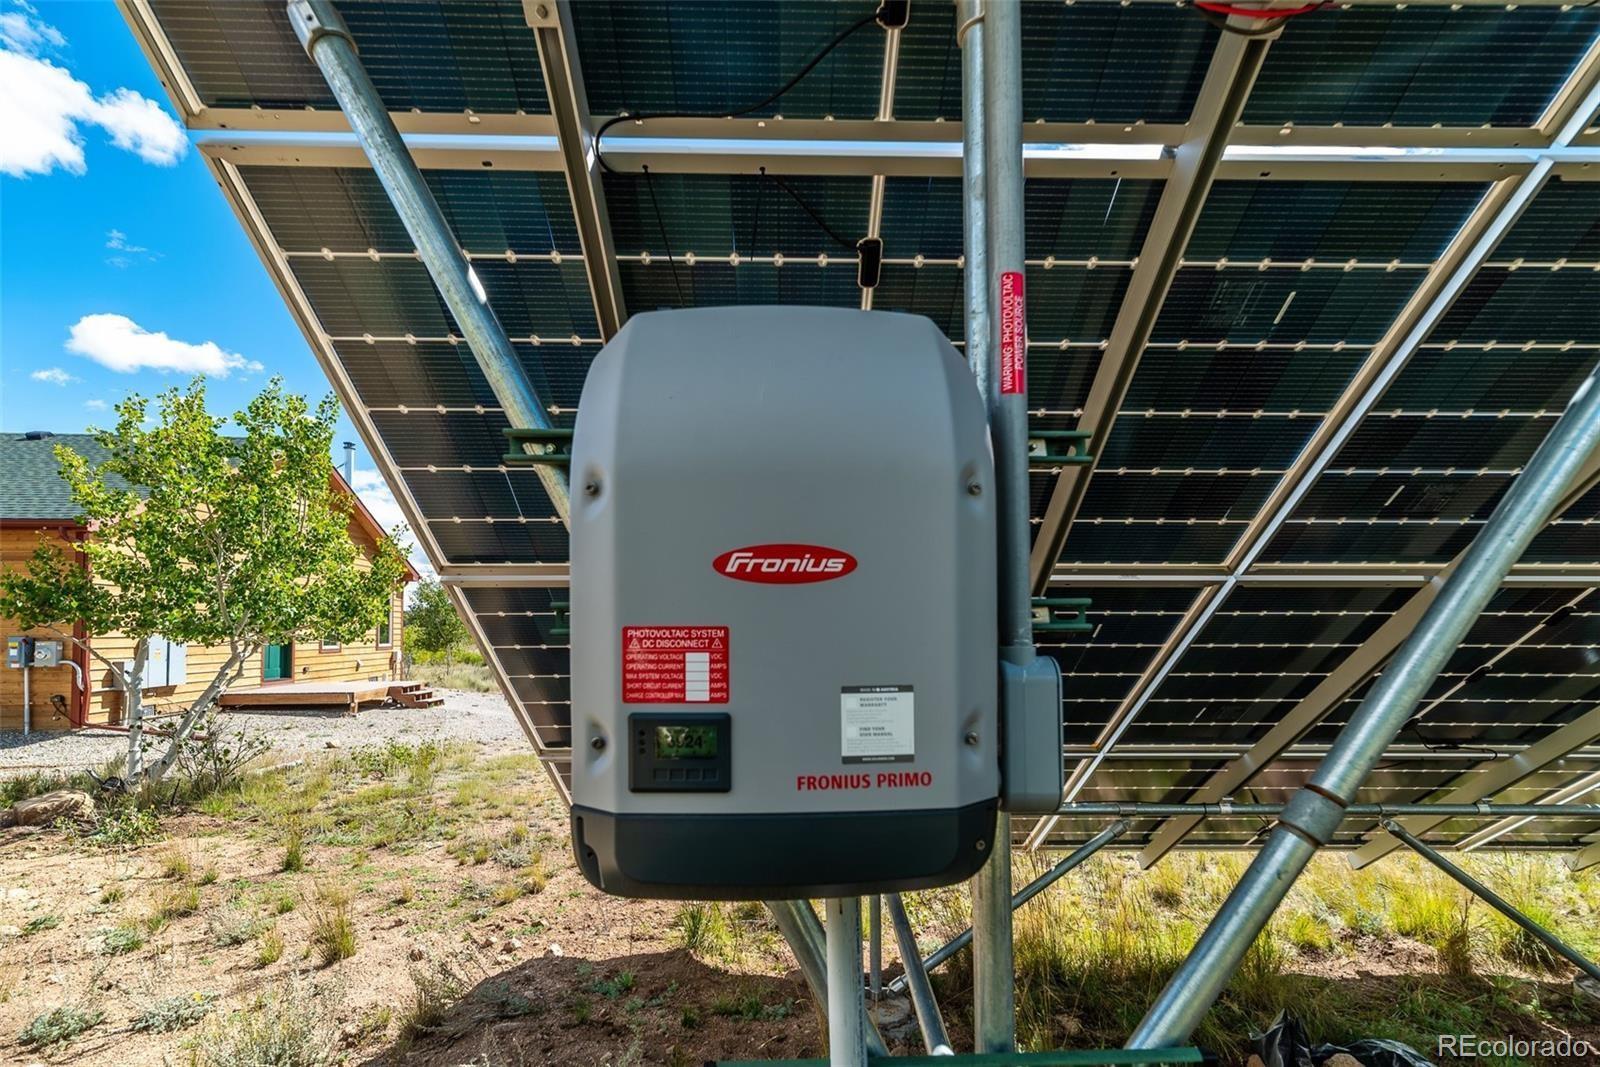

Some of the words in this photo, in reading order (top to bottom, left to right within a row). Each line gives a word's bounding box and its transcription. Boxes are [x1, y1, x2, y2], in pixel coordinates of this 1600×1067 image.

[1002, 274, 1014, 342] PHOTOVOLTAIC
[1014, 295, 1024, 335] SOURCE
[1014, 336, 1024, 370] POWER
[1002, 343, 1014, 391] WARNING:
[725, 552, 847, 573] Fronius
[627, 629, 689, 638] PHOTOVOLTAIC
[690, 629, 725, 638] SYSTEM
[642, 639, 655, 648] DC
[656, 639, 709, 648] DISCONNECT
[797, 773, 872, 791] FRONIUS
[877, 771, 932, 789] PRIMO
